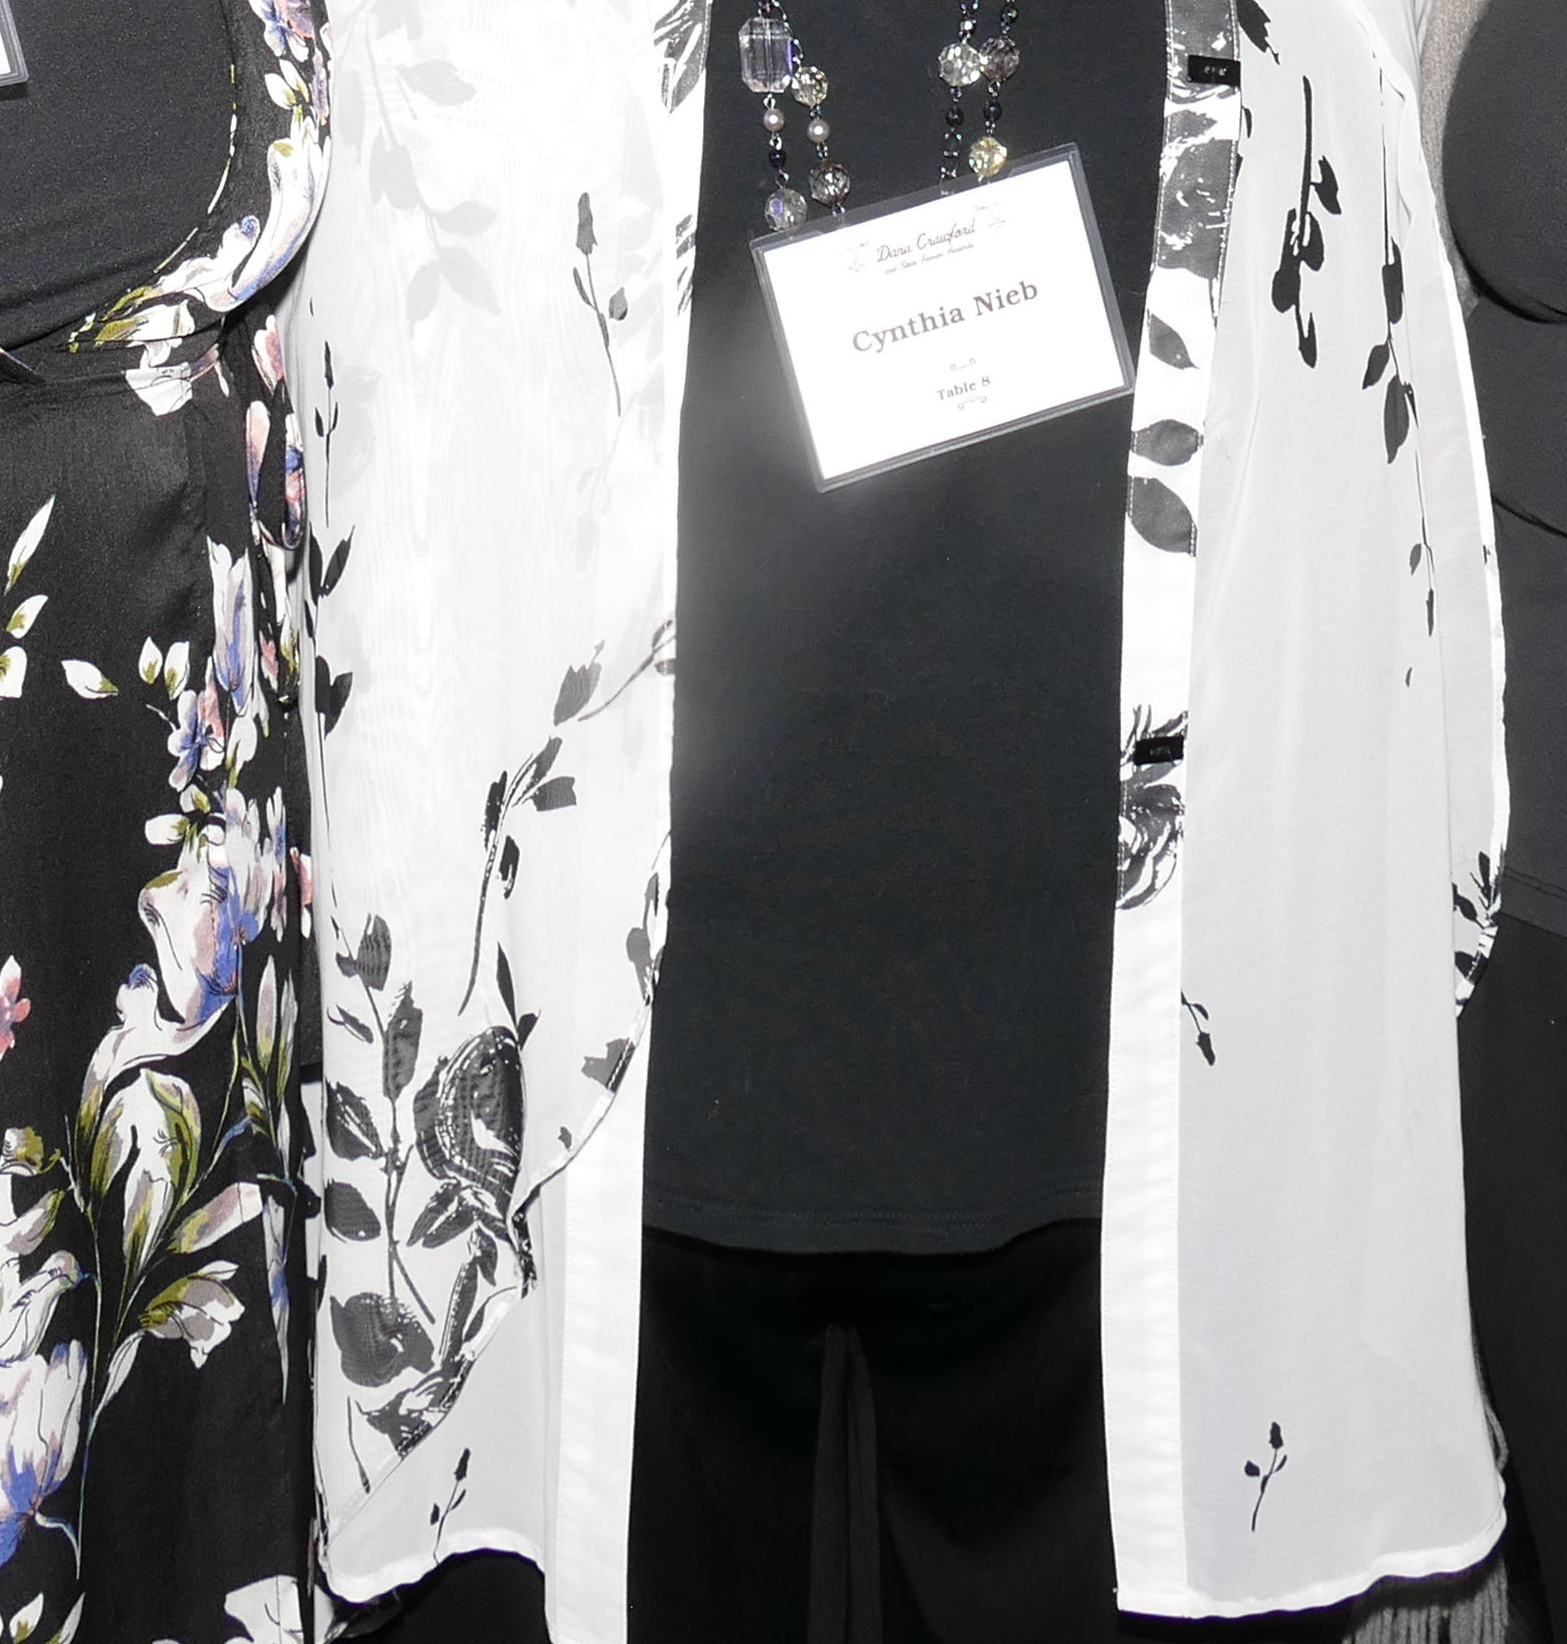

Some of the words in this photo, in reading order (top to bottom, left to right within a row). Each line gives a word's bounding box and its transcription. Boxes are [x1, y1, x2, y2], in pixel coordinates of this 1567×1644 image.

[851, 304, 966, 354] Cynthia
[972, 280, 1039, 317] Nieb
[937, 378, 977, 402] Table
[981, 374, 992, 388] 8
